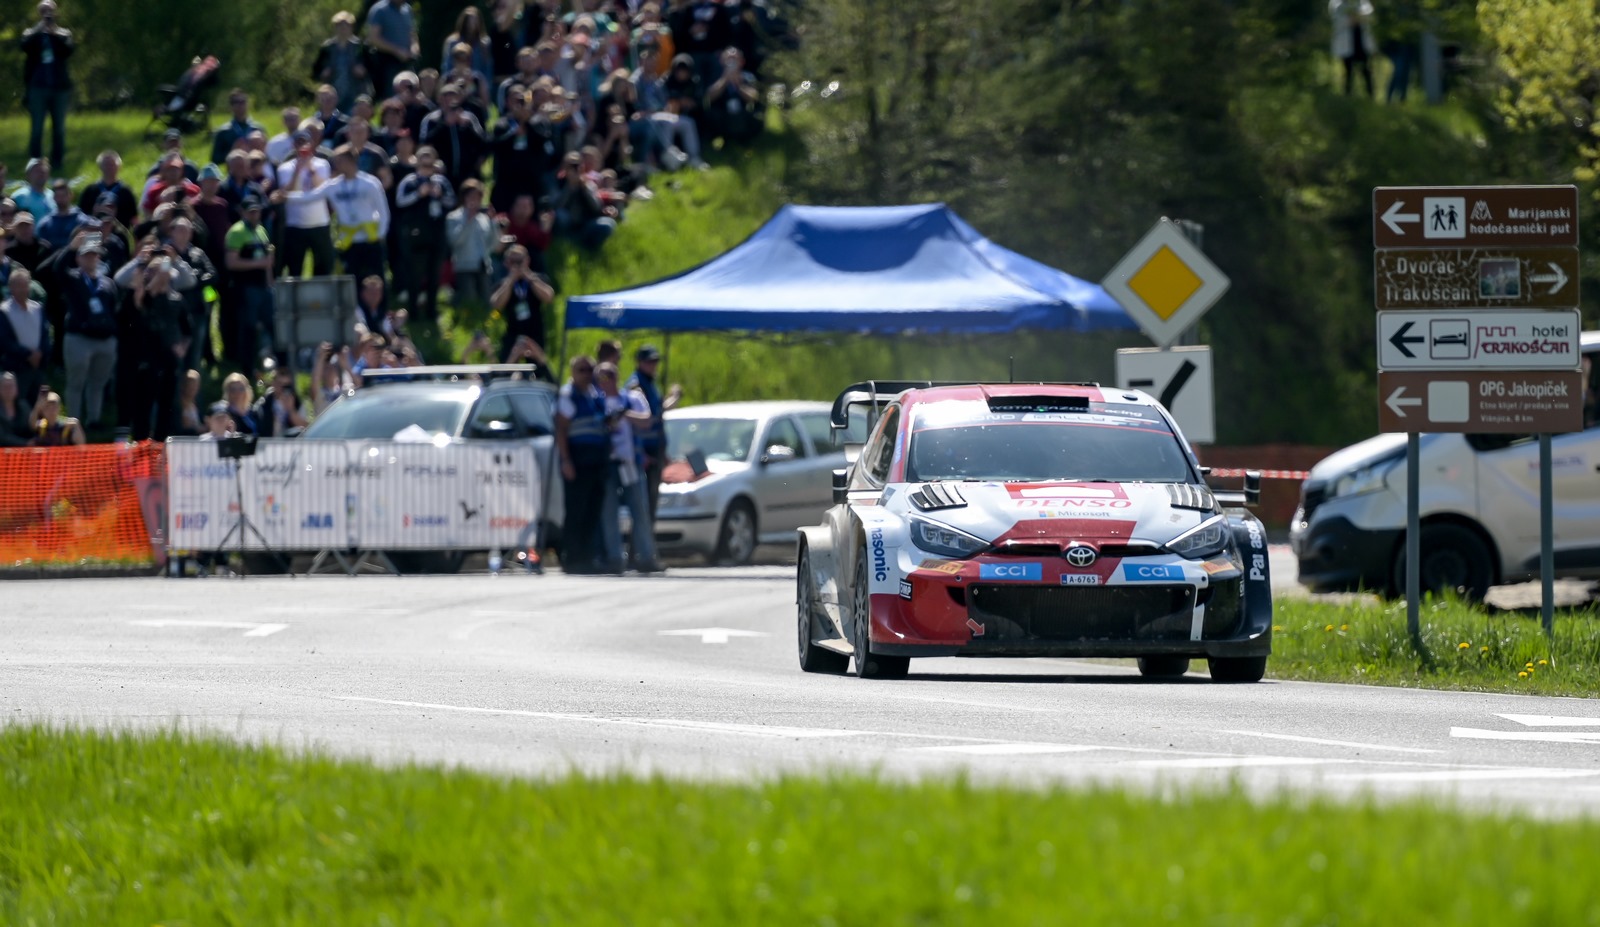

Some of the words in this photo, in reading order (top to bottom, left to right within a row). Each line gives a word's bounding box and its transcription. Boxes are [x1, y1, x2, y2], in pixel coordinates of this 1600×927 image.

[1508, 207, 1570, 221] Marijanski
[1550, 223, 1570, 236] put
[1397, 257, 1456, 274] Dvorac
[1532, 325, 1568, 337] hotel
[1480, 381, 1505, 396] OPG
[1508, 380, 1568, 400] Jakopiček
[1093, 407, 1143, 417] Racing
[1017, 499, 1132, 508] DENSO
[869, 518, 890, 582] Pnasonic
[1069, 576, 1096, 584] A-6765
